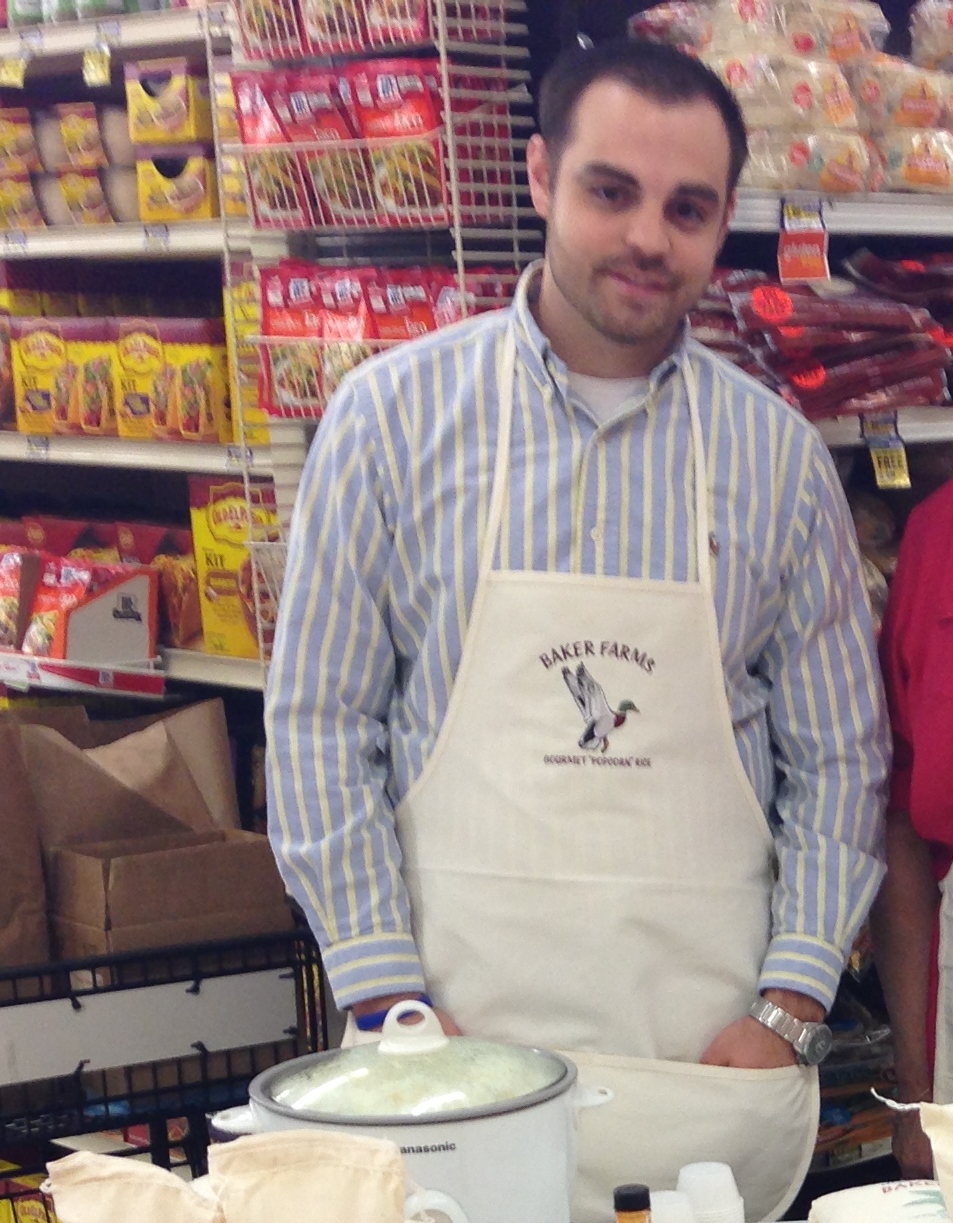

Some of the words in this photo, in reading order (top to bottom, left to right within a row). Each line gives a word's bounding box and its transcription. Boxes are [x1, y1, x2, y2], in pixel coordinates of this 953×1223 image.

[539, 639, 595, 669] BAKER
[600, 640, 656, 675] FARMS
[400, 1141, 456, 1154] anasonic
[882, 1181, 940, 1193] BAKE
